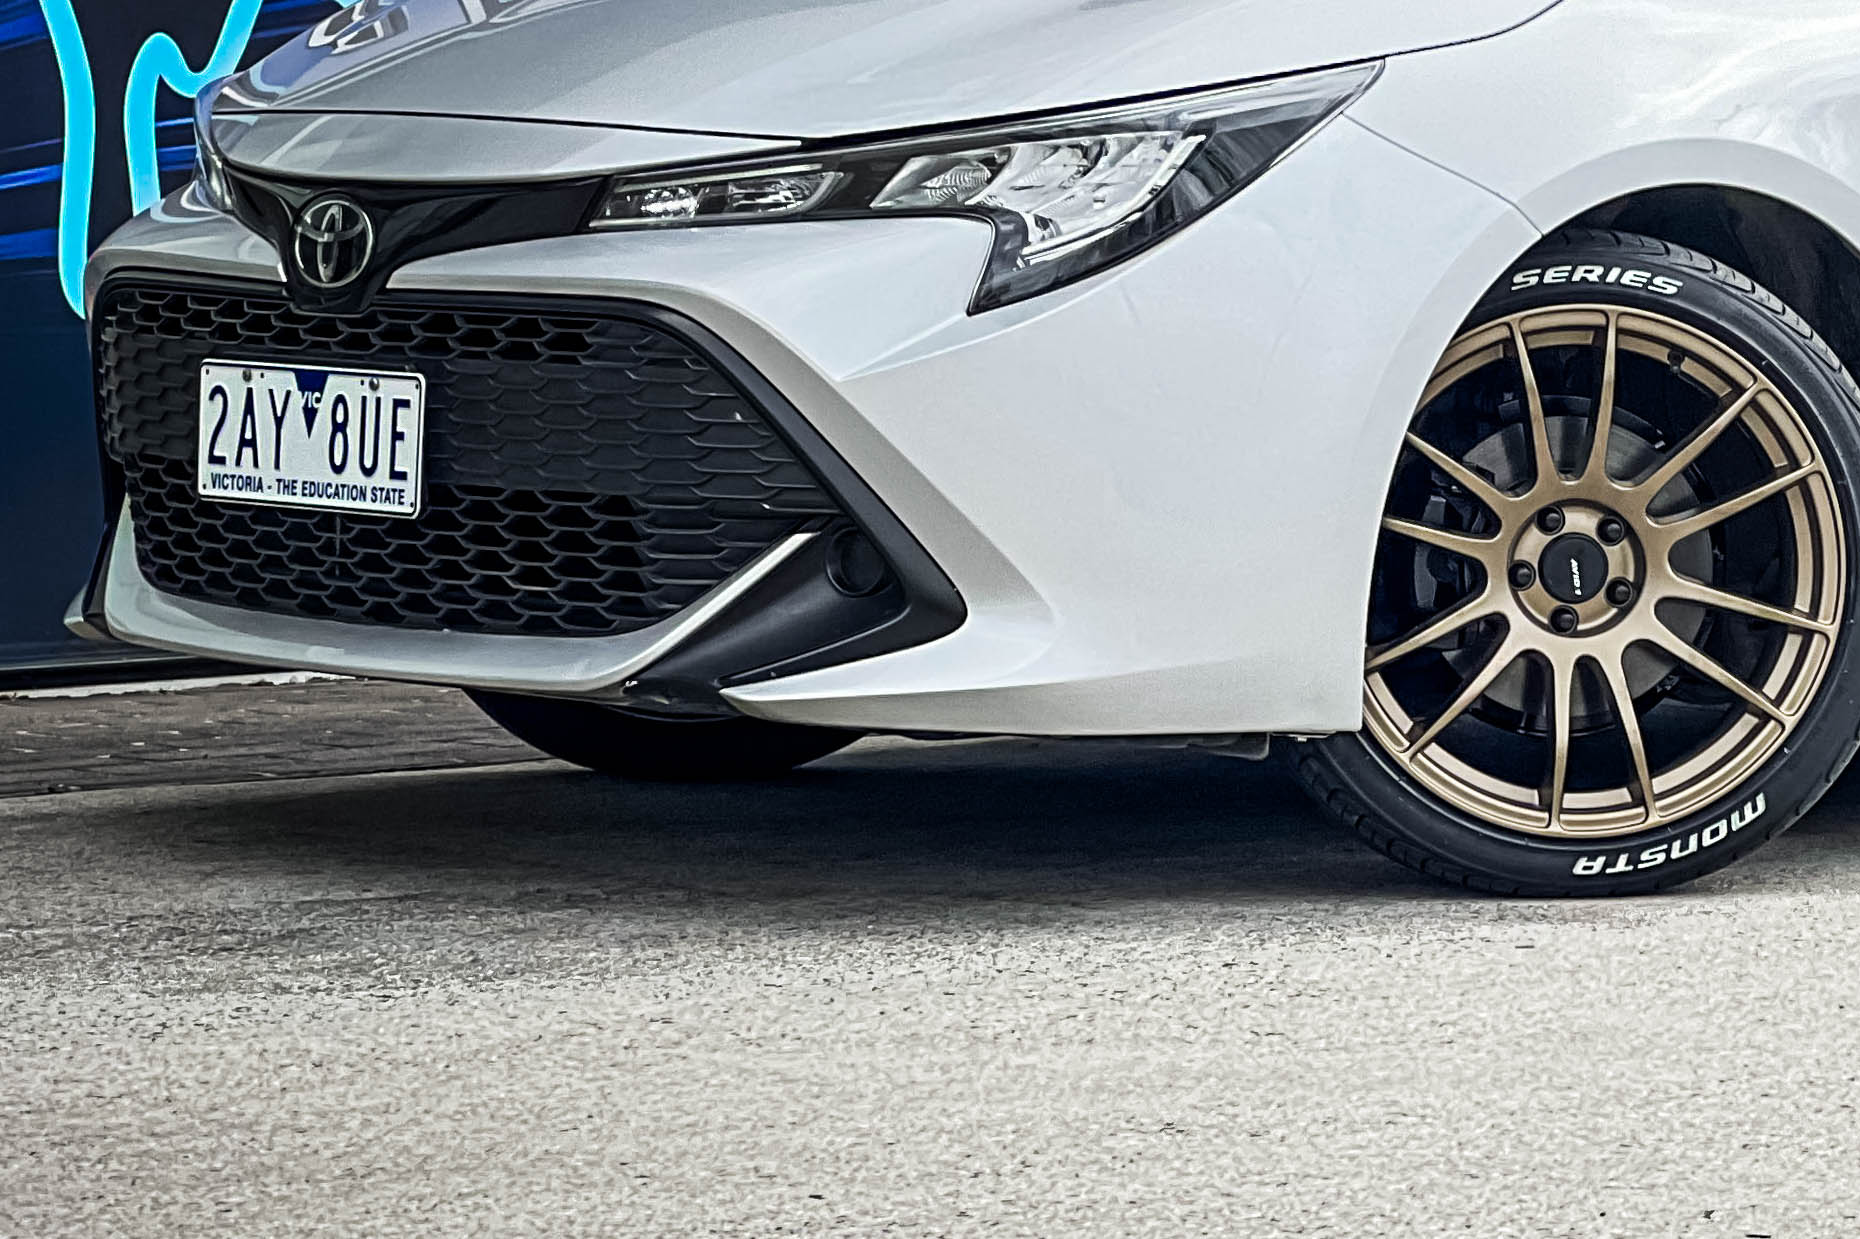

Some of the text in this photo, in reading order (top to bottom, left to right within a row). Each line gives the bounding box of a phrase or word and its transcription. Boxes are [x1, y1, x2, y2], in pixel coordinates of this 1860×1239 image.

[1511, 265, 1684, 295] SERIES
[301, 391, 322, 409] VIC
[207, 384, 412, 481] 2AY 8UE
[210, 472, 264, 493] VICTORIA
[275, 478, 298, 496] THE
[301, 480, 367, 502] EDUCATION
[370, 486, 405, 505] STATE
